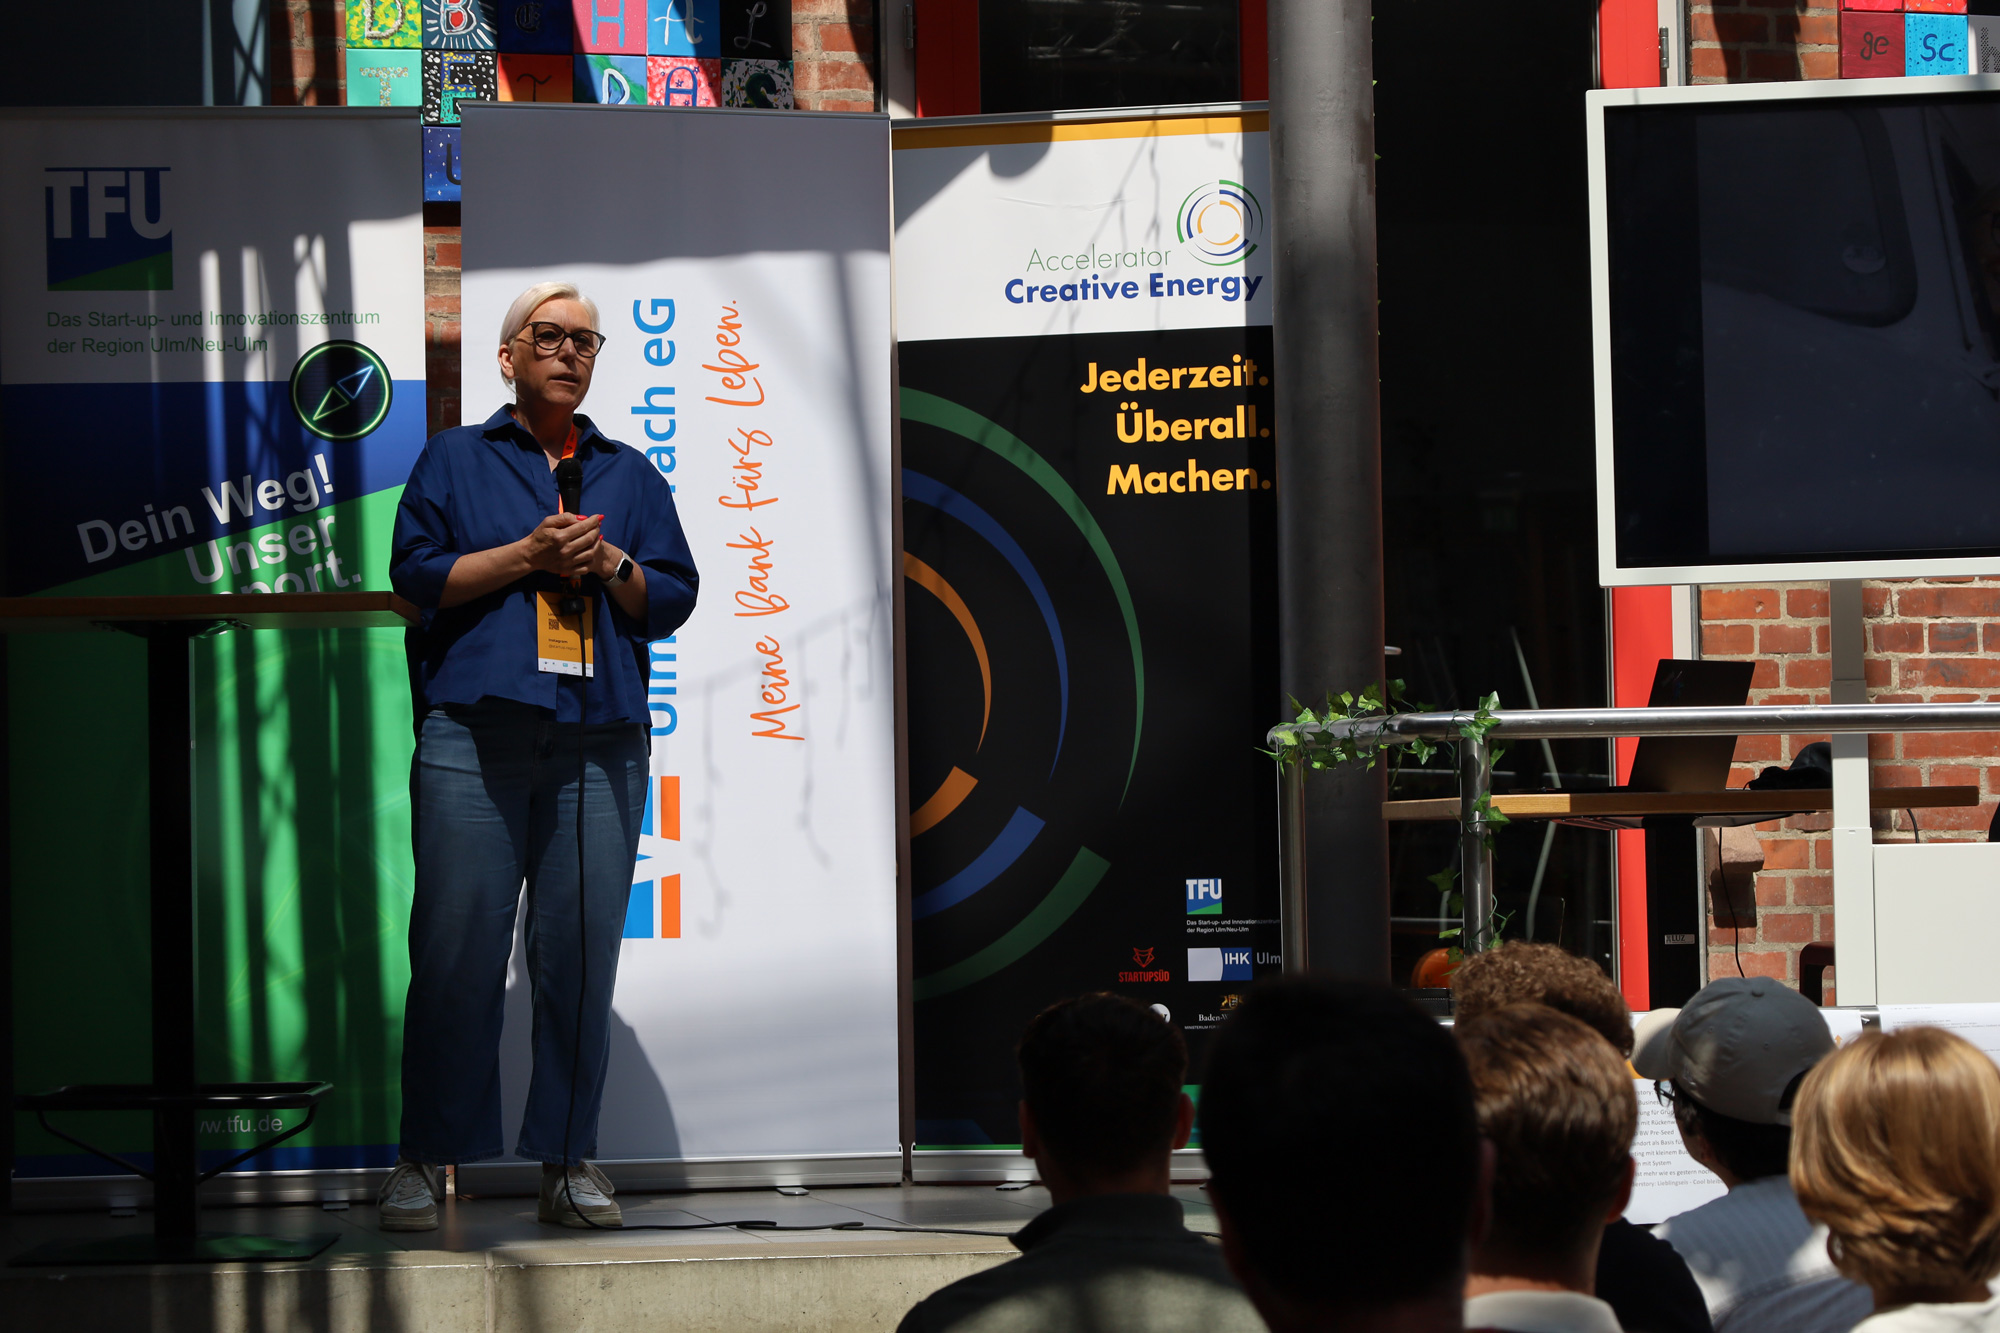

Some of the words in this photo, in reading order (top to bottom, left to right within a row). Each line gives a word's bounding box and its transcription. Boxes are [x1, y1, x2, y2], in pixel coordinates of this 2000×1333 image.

[45, 168, 172, 240] TFU
[1026, 243, 1171, 272] Accelerator
[1004, 274, 1139, 304] Creative
[1150, 272, 1263, 302] Energy
[47, 311, 82, 327] Das
[88, 310, 165, 331] Start-up-
[171, 310, 203, 326] und
[210, 309, 381, 326] Innovationszentrum
[633, 298, 677, 366] eG
[47, 337, 76, 353] der
[83, 337, 147, 357] Region
[151, 336, 269, 353] Ulm/Neu-Ulm
[702, 300, 765, 406] Leben.
[1080, 354, 1270, 394] Jederzeit.
[1116, 401, 1271, 444] Überall.
[718, 427, 779, 511] fürs
[1106, 459, 1272, 495] Machen.
[76, 503, 195, 564] Dein
[201, 453, 335, 526] Weg!
[184, 515, 336, 585] Unser
[726, 526, 790, 616] Bank
[750, 635, 805, 741] Meine
[1186, 878, 1222, 900] TFU
[1118, 969, 1170, 983] STARTUPSÜD
[1224, 952, 1250, 966] IHK
[1256, 952, 1281, 965] Ulm
[1198, 1013, 1229, 1022] Baden-W
[199, 1113, 284, 1135] w.tfu.de
